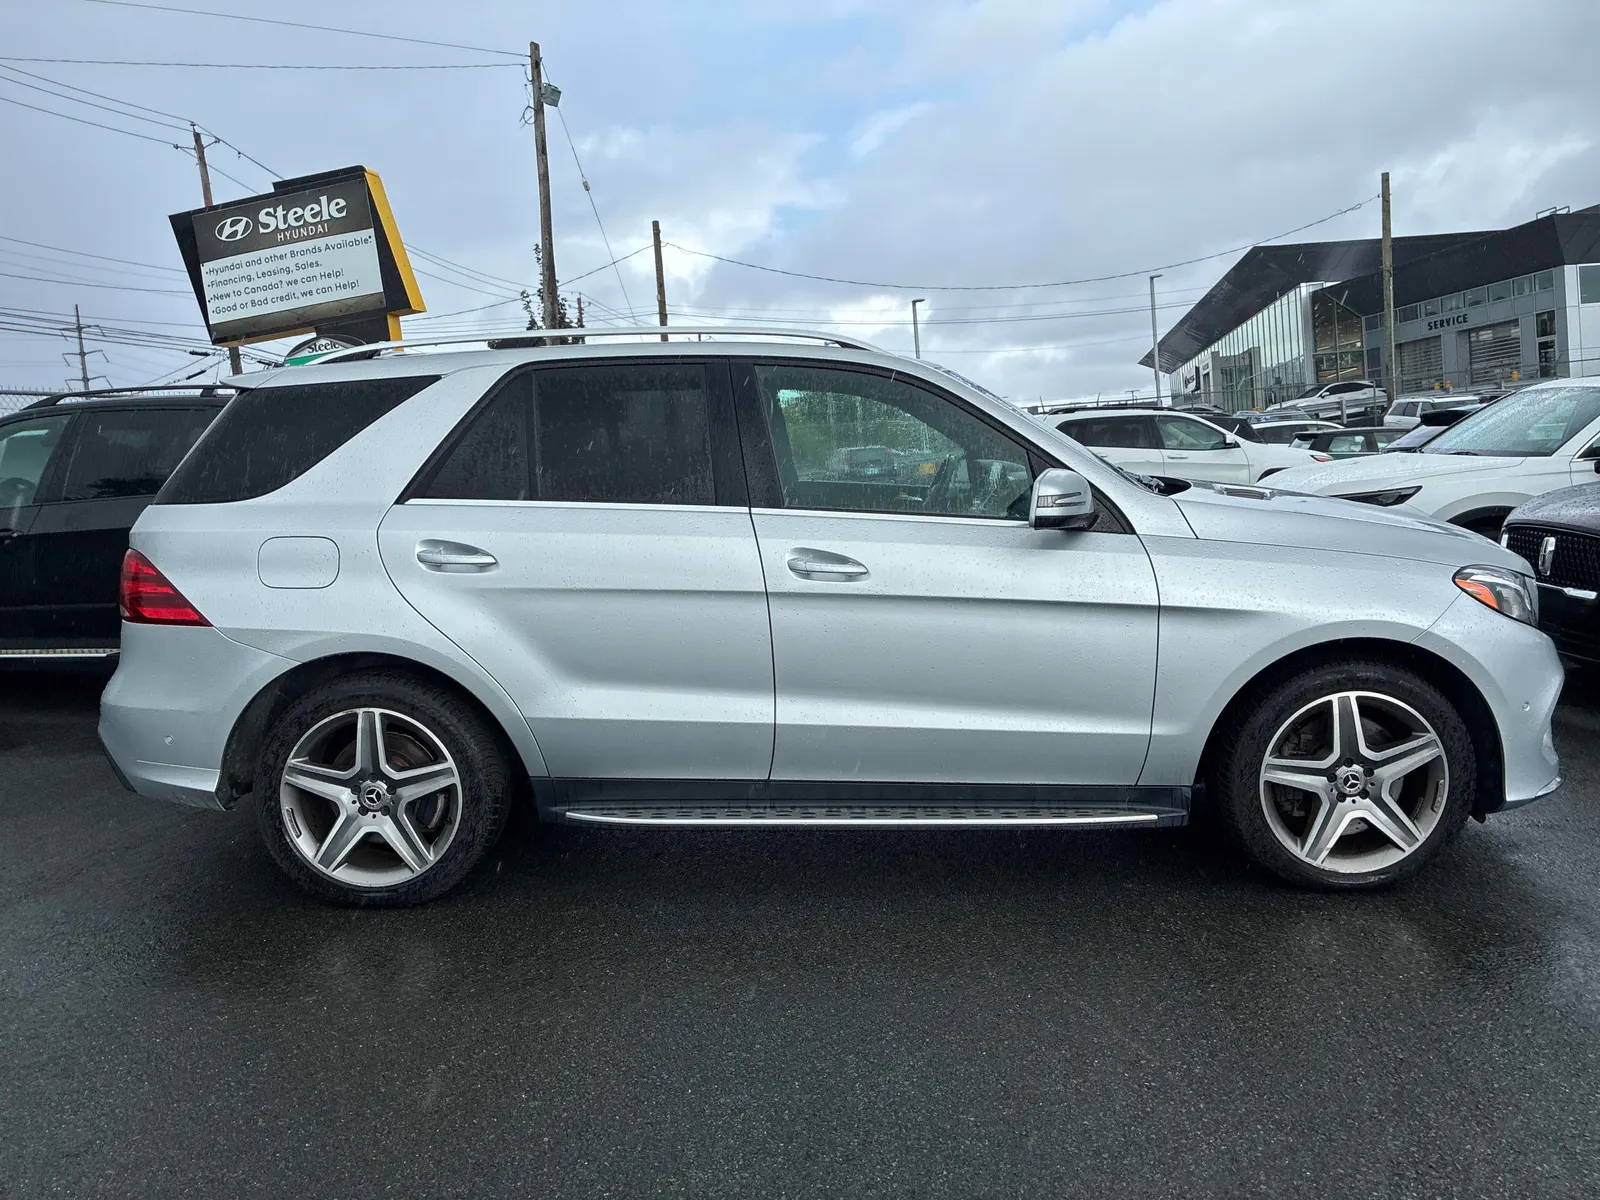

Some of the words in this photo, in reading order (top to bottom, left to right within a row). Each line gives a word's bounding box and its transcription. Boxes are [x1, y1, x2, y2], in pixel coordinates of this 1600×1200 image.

[258, 195, 347, 234] Steele
[277, 225, 328, 242] HYUNDAI
[245, 257, 262, 266] and
[264, 252, 287, 264] other
[290, 246, 322, 258] Brands
[256, 266, 294, 279] Leasing,
[295, 260, 322, 271] Sales.
[244, 280, 283, 294] Canada?
[286, 278, 298, 286] we
[300, 274, 318, 284] can
[320, 268, 344, 280] Help!
[250, 297, 268, 308] Bad
[270, 292, 300, 303] credit,
[300, 290, 314, 298] we
[316, 286, 332, 294] can
[335, 280, 360, 291] Help!
[1428, 314, 1468, 330] SERVICE
